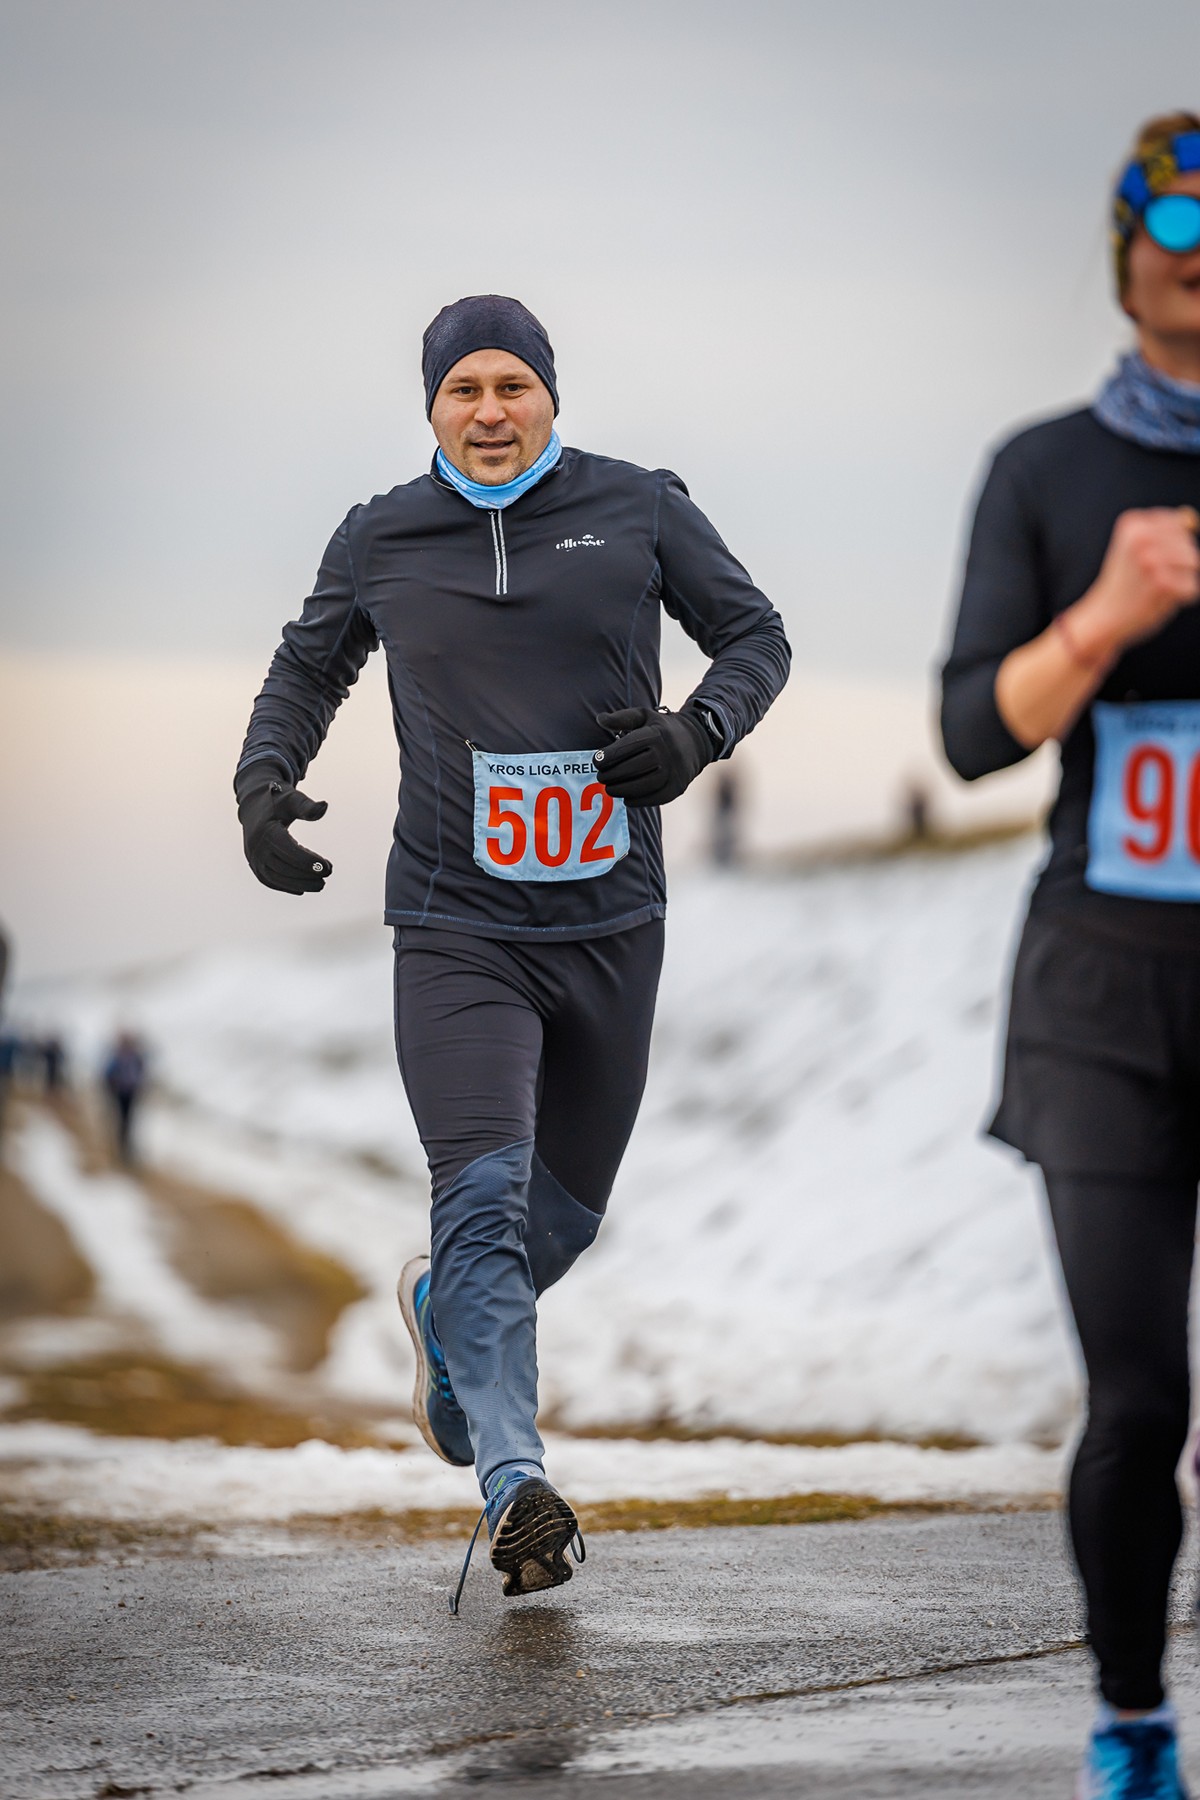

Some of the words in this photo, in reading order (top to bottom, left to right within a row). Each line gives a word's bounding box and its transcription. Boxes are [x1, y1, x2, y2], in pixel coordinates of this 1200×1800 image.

[488, 763, 525, 776] KROS
[529, 764, 561, 775] LIGA
[563, 763, 598, 775] PREL
[1122, 740, 1200, 867] 9
[486, 782, 615, 868] 502
